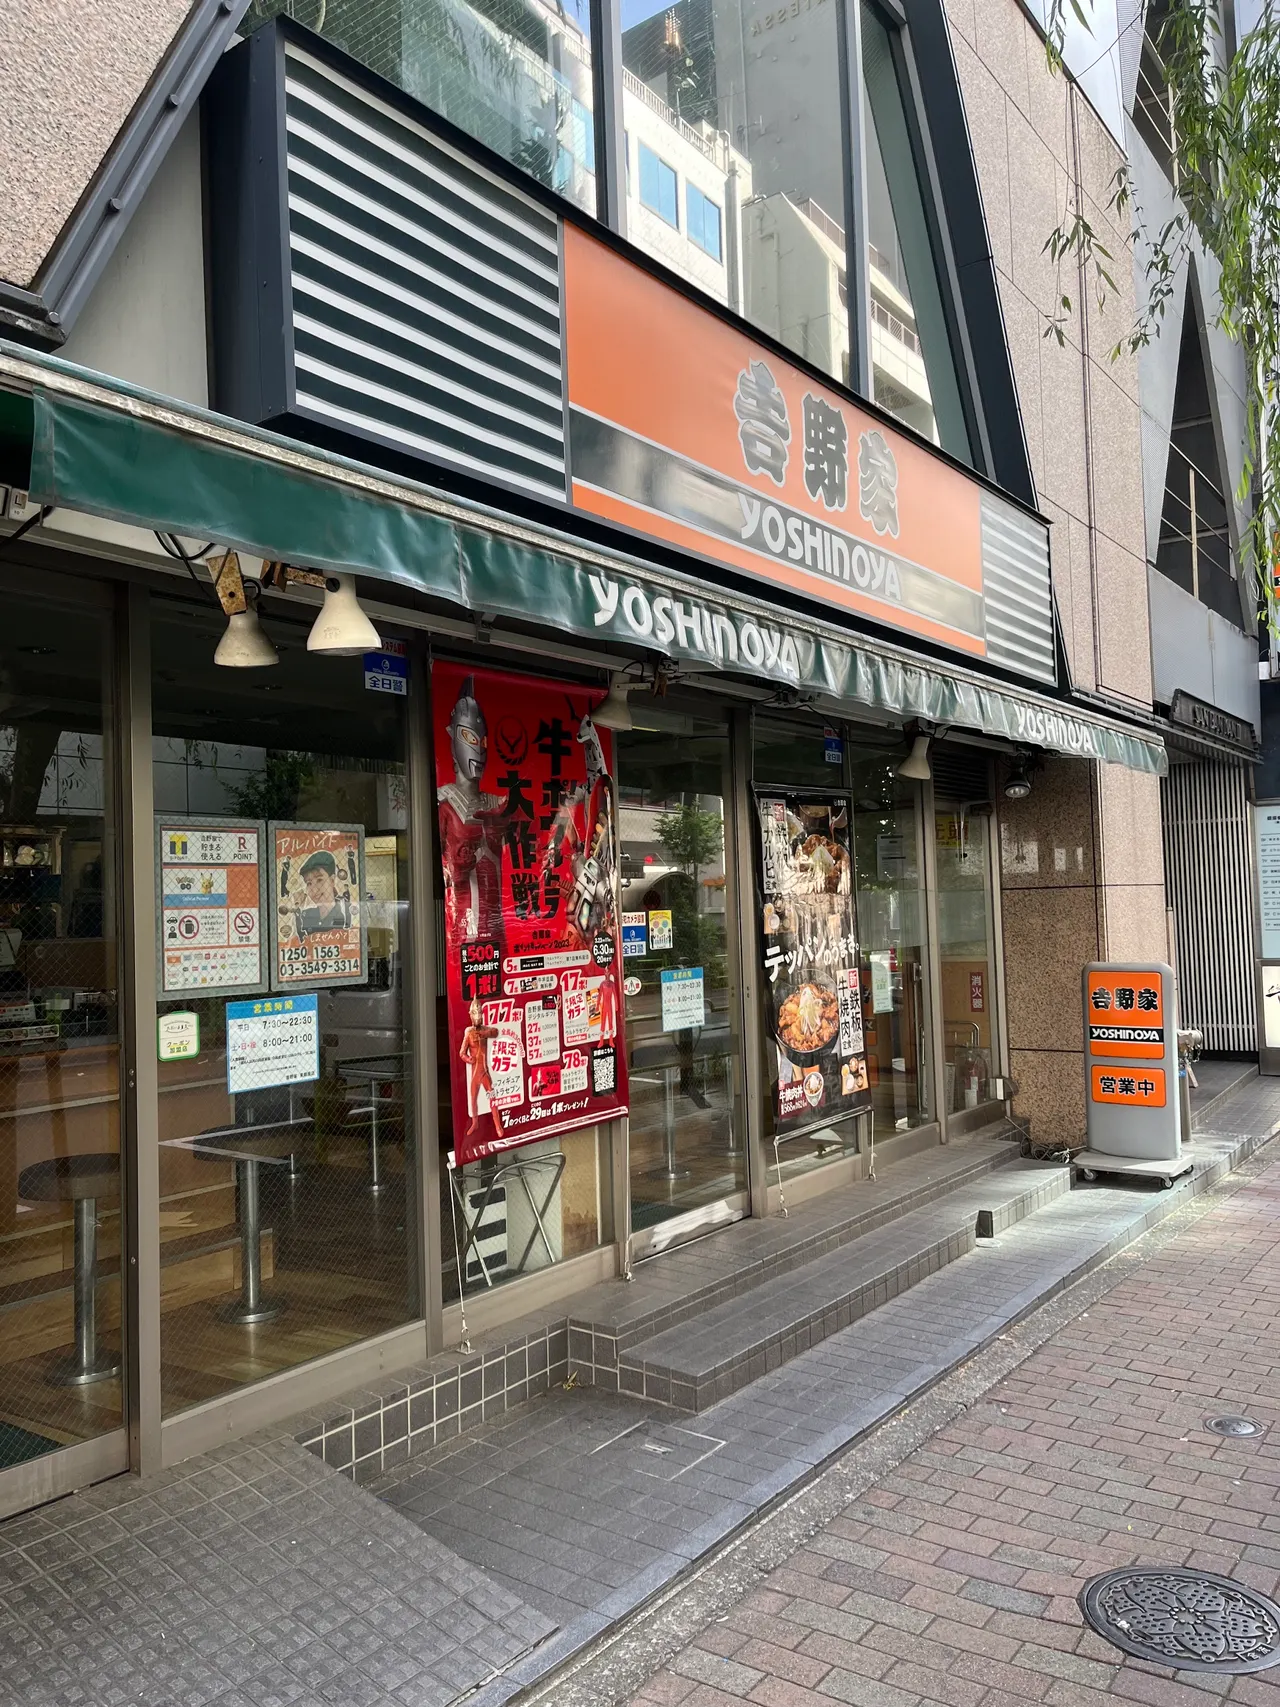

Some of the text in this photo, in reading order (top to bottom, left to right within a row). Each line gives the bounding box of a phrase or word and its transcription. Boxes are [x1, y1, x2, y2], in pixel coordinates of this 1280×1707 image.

[733, 358, 900, 540] 吉野家
[738, 491, 902, 601] YOSHINOYA
[588, 575, 801, 679] YOSHINOYA
[369, 675, 403, 692] 全日警
[1013, 703, 1094, 752] YOSHINOYA
[277, 834, 336, 854] アルバイト
[497, 770, 541, 920] 大作戦
[281, 945, 340, 961] 1250 1563
[280, 959, 359, 976] 03-3549-3314
[971, 975, 982, 1009] 消火器
[1091, 987, 1159, 1012] 吉野家
[567, 1004, 586, 1020] カラー
[838, 976, 851, 1038] 牛焼肉
[238, 1023, 249, 1031] 平日
[1092, 1028, 1160, 1041] YOSHINOYA
[498, 1041, 517, 1056] 限定
[492, 1056, 517, 1072] カラー
[1100, 1076, 1155, 1097] 営業中
